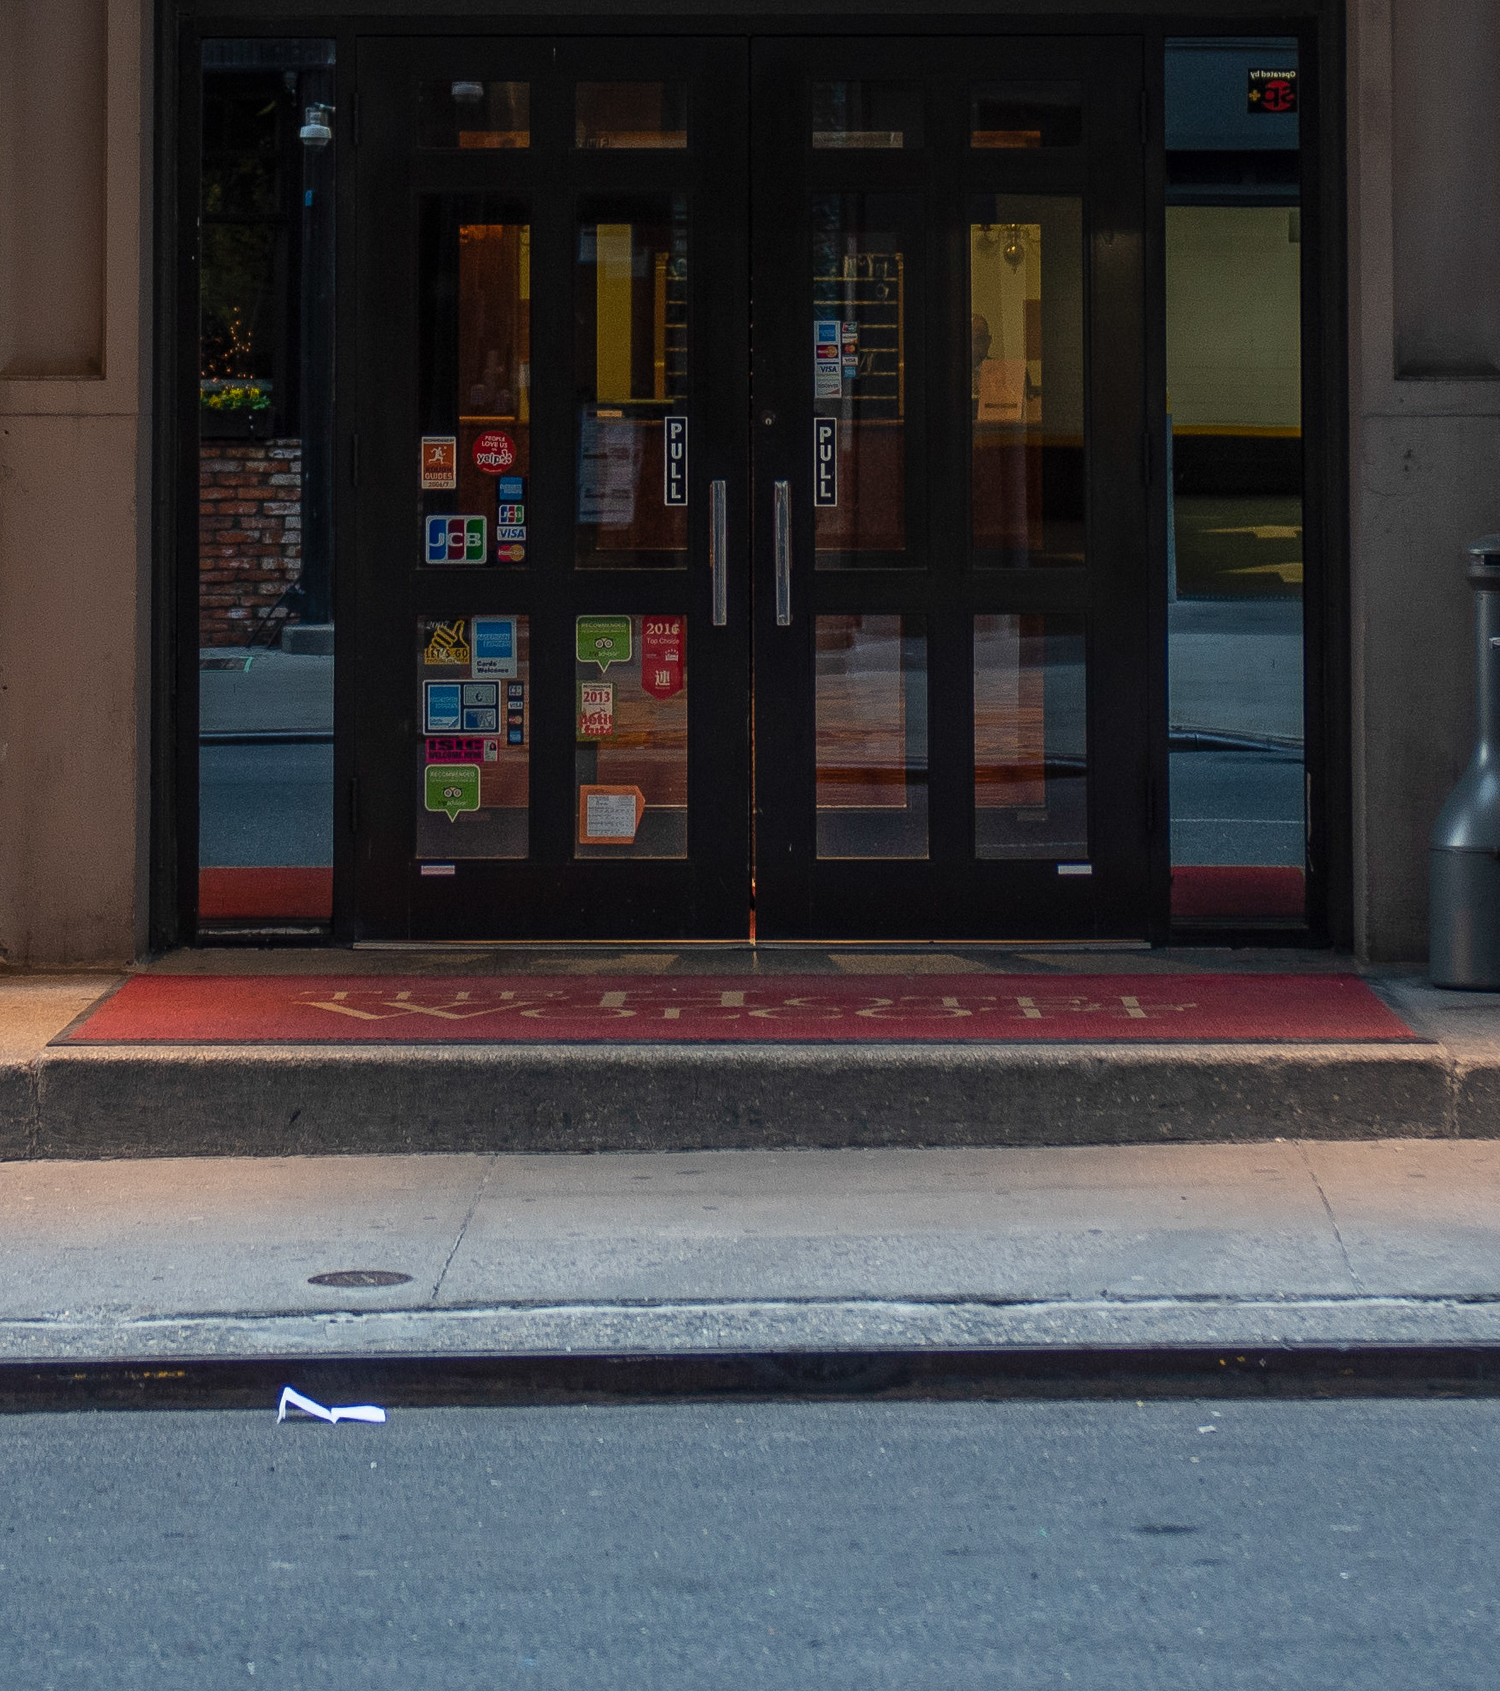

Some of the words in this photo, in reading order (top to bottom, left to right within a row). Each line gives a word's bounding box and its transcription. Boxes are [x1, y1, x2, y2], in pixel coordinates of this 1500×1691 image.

[819, 365, 838, 373] VISA
[670, 423, 682, 499] PULL
[818, 426, 832, 499] PULL
[425, 472, 453, 480] GUIDES
[500, 528, 525, 538] VISA
[429, 532, 482, 548] JCB
[647, 637, 658, 645] Top
[455, 649, 468, 658] GO
[583, 691, 610, 702] 2013
[429, 740, 482, 750] ISIC
[299, 990, 569, 1001] THE
[291, 1000, 1190, 1020] WOLCOTT
